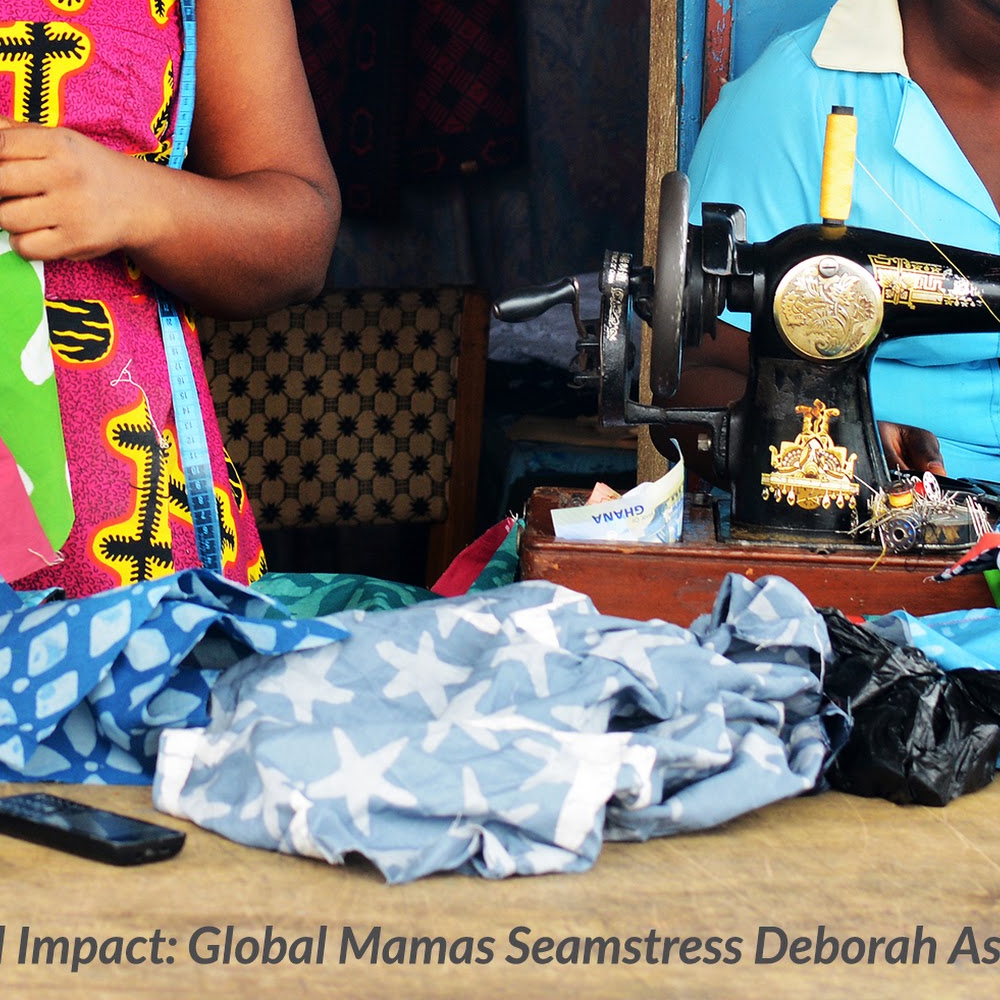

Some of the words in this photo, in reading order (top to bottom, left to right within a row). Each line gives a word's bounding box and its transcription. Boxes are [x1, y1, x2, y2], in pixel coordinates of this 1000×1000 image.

[174, 362, 182, 370] 17
[177, 377, 185, 385] 16
[180, 391, 188, 399] 15
[182, 407, 191, 415] 14
[591, 504, 644, 524] GHANA
